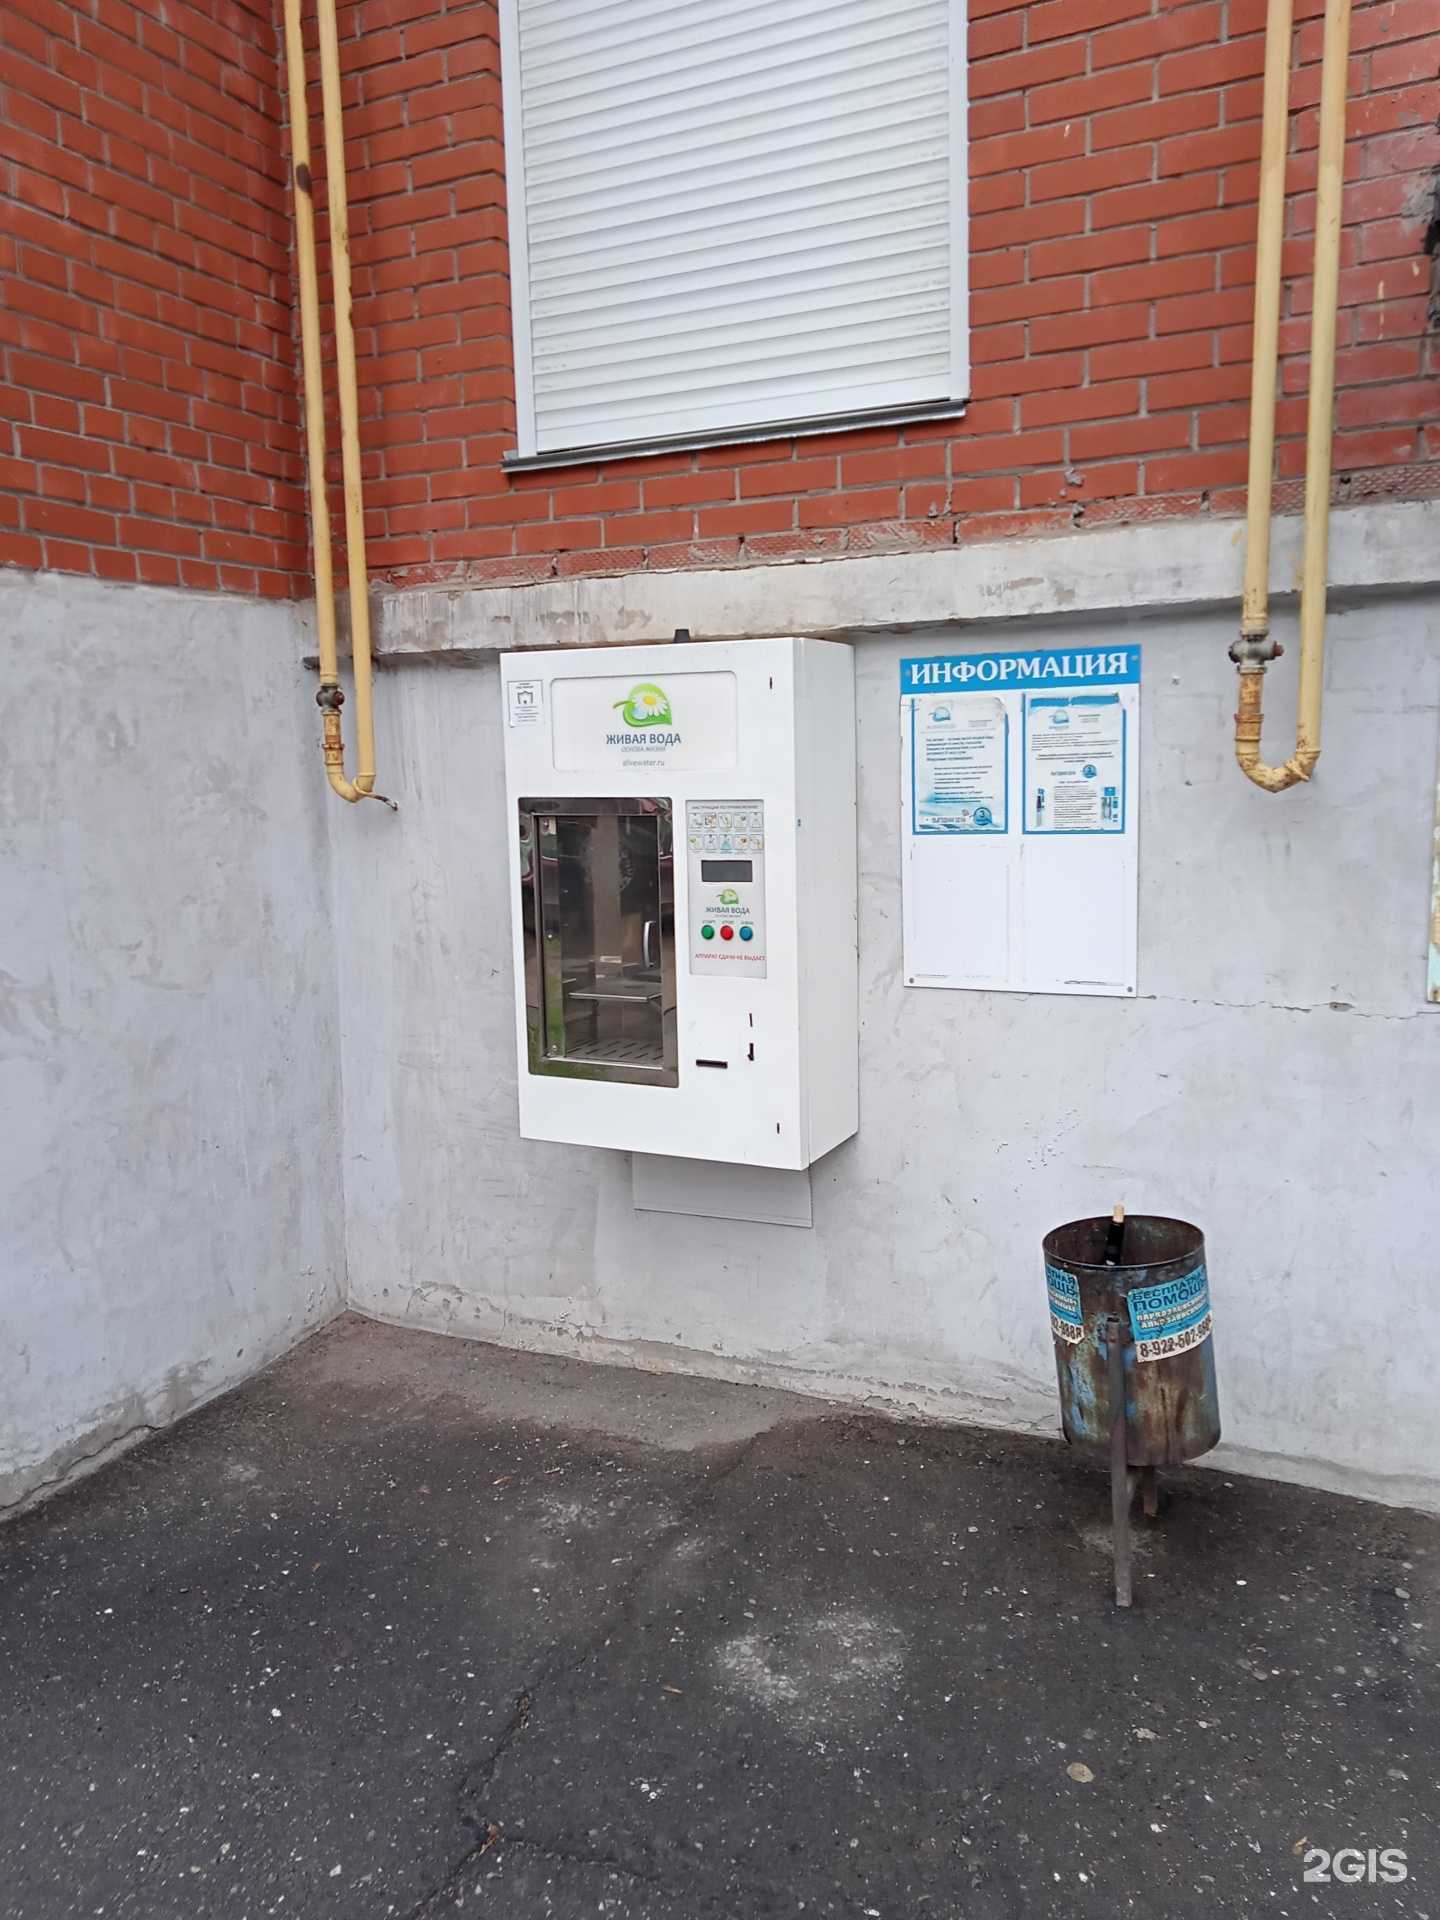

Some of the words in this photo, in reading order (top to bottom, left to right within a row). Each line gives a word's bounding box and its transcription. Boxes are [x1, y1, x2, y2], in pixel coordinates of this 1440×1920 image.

[911, 651, 1128, 685] ИНФОРМАЦИЯ
[606, 733, 647, 745] ЖИВАЯ
[649, 733, 682, 747] ВОДА
[731, 907, 751, 915] ВОДА
